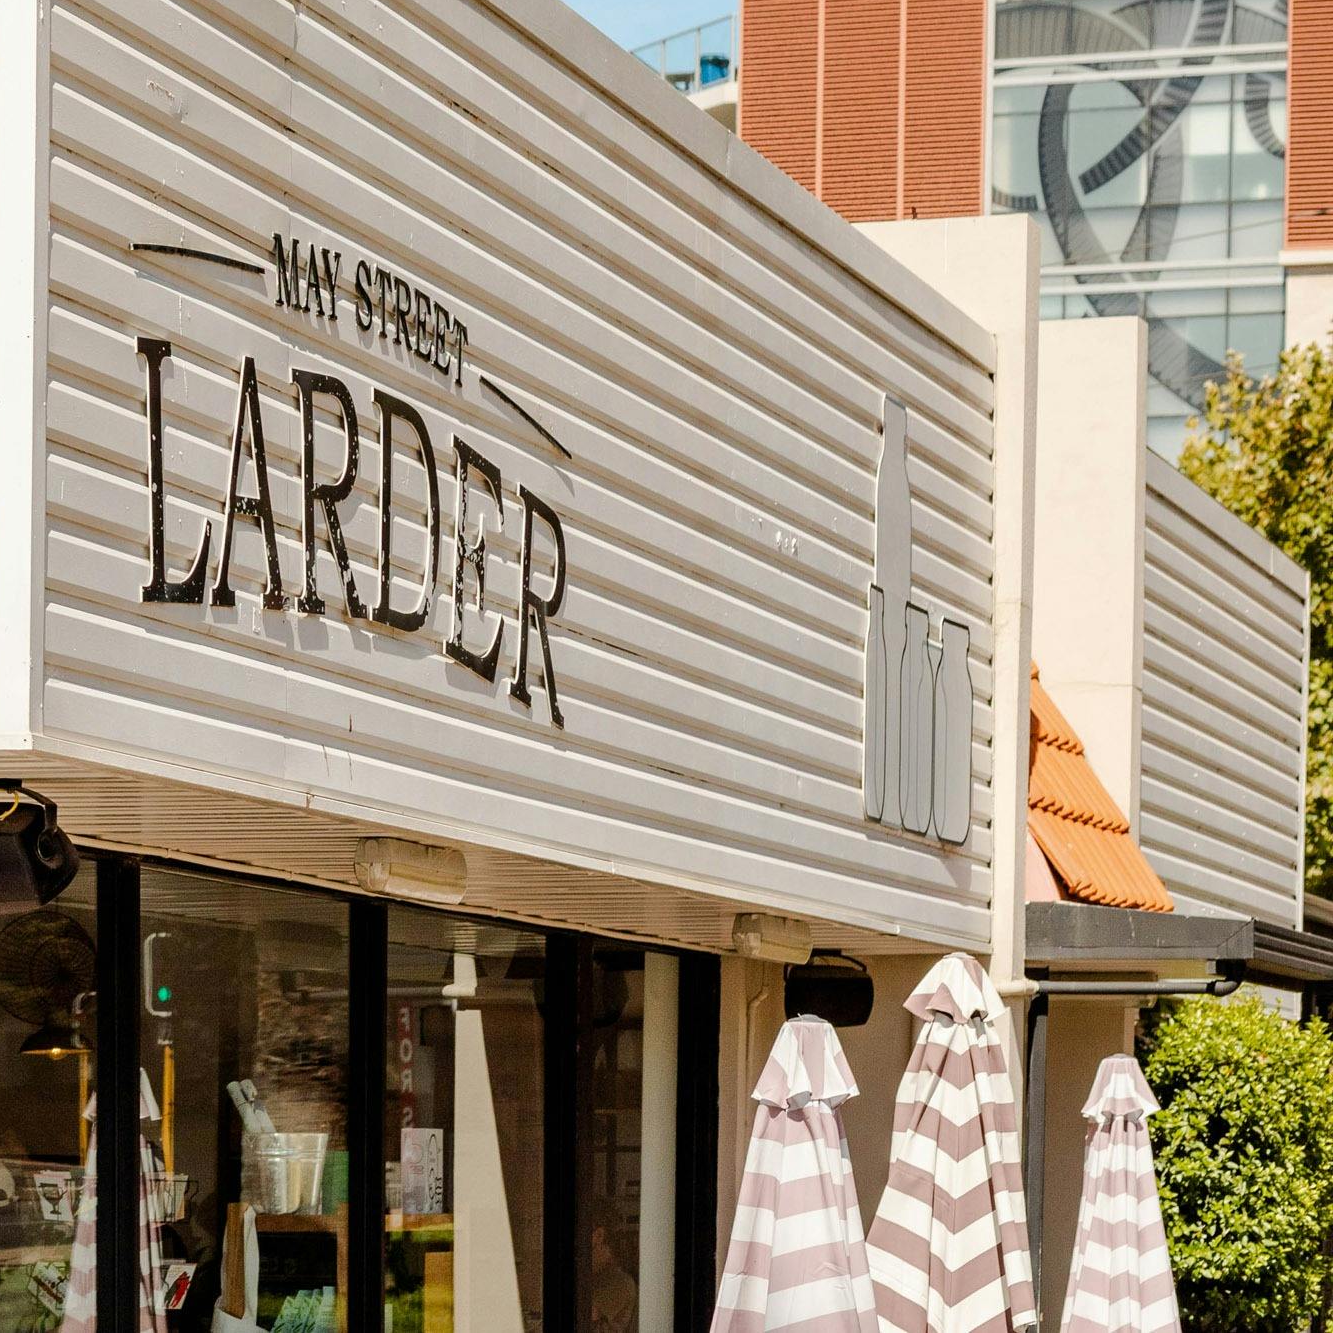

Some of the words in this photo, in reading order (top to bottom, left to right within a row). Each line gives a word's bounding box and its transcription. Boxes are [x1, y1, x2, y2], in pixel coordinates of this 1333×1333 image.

[273, 233, 341, 320] MAY
[355, 260, 469, 387] STREET
[134, 335, 565, 730] LARDER
